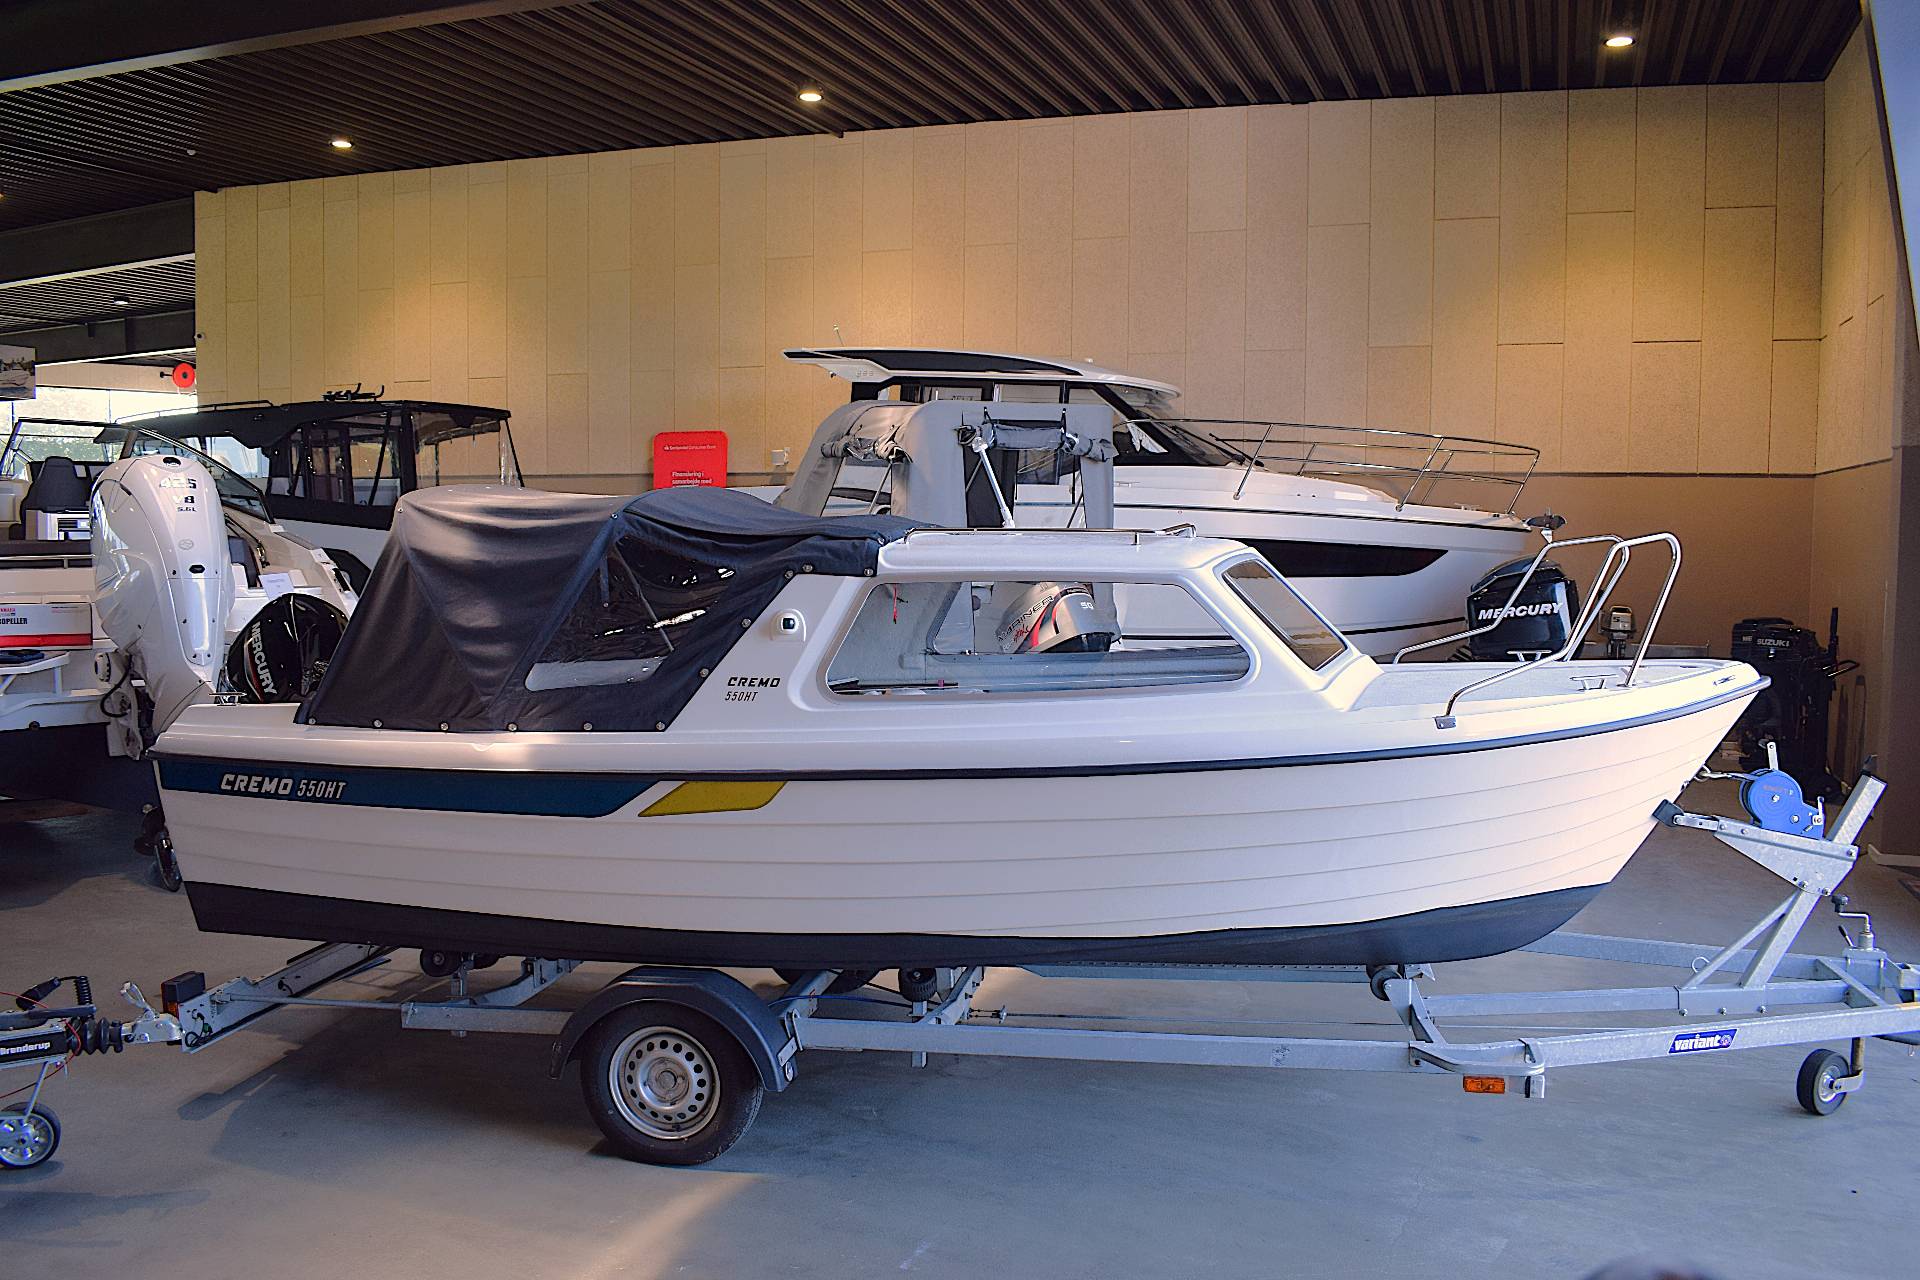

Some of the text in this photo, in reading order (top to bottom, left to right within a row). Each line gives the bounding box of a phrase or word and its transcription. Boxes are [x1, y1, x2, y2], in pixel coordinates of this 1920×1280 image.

[1478, 602, 1563, 620] MERCURY
[1757, 639, 1790, 647] SUZUKI
[251, 621, 278, 694] MERCURY
[727, 677, 781, 688] CREMO
[725, 691, 759, 702] 550HT
[221, 774, 346, 799] CREMO 550HT
[1674, 1034, 1721, 1051] variant
